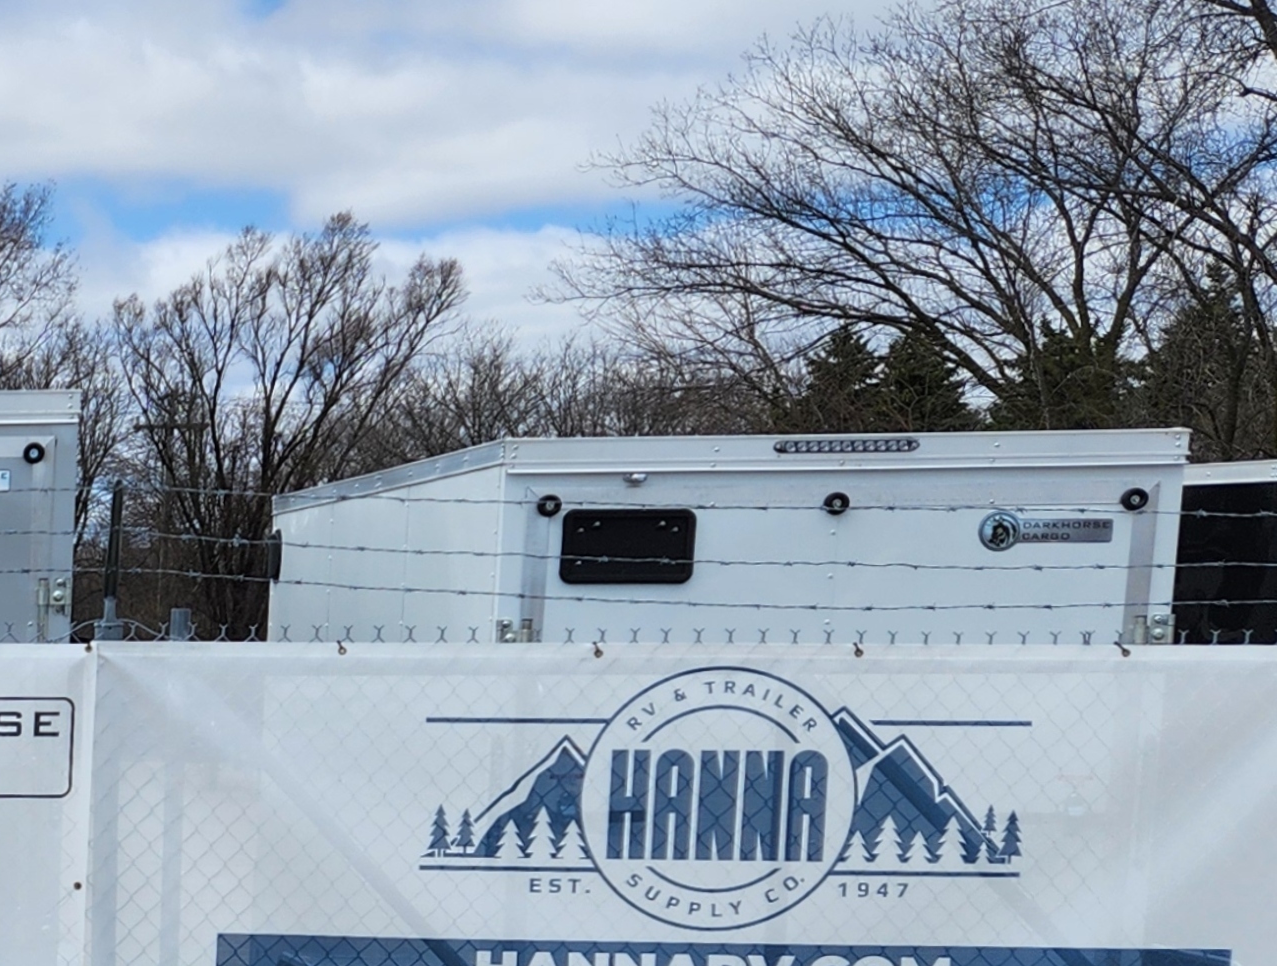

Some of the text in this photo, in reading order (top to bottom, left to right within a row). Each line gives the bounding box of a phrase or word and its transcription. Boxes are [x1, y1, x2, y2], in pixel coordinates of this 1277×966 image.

[1022, 520, 1111, 530] DARKHORSE
[1021, 532, 1071, 541] CARGO
[627, 680, 818, 733] RV & TRAILER
[606, 748, 829, 862] HANNA
[529, 878, 592, 895] EST.
[838, 882, 910, 899] 1947
[626, 873, 806, 918] SUPPLY CO.
